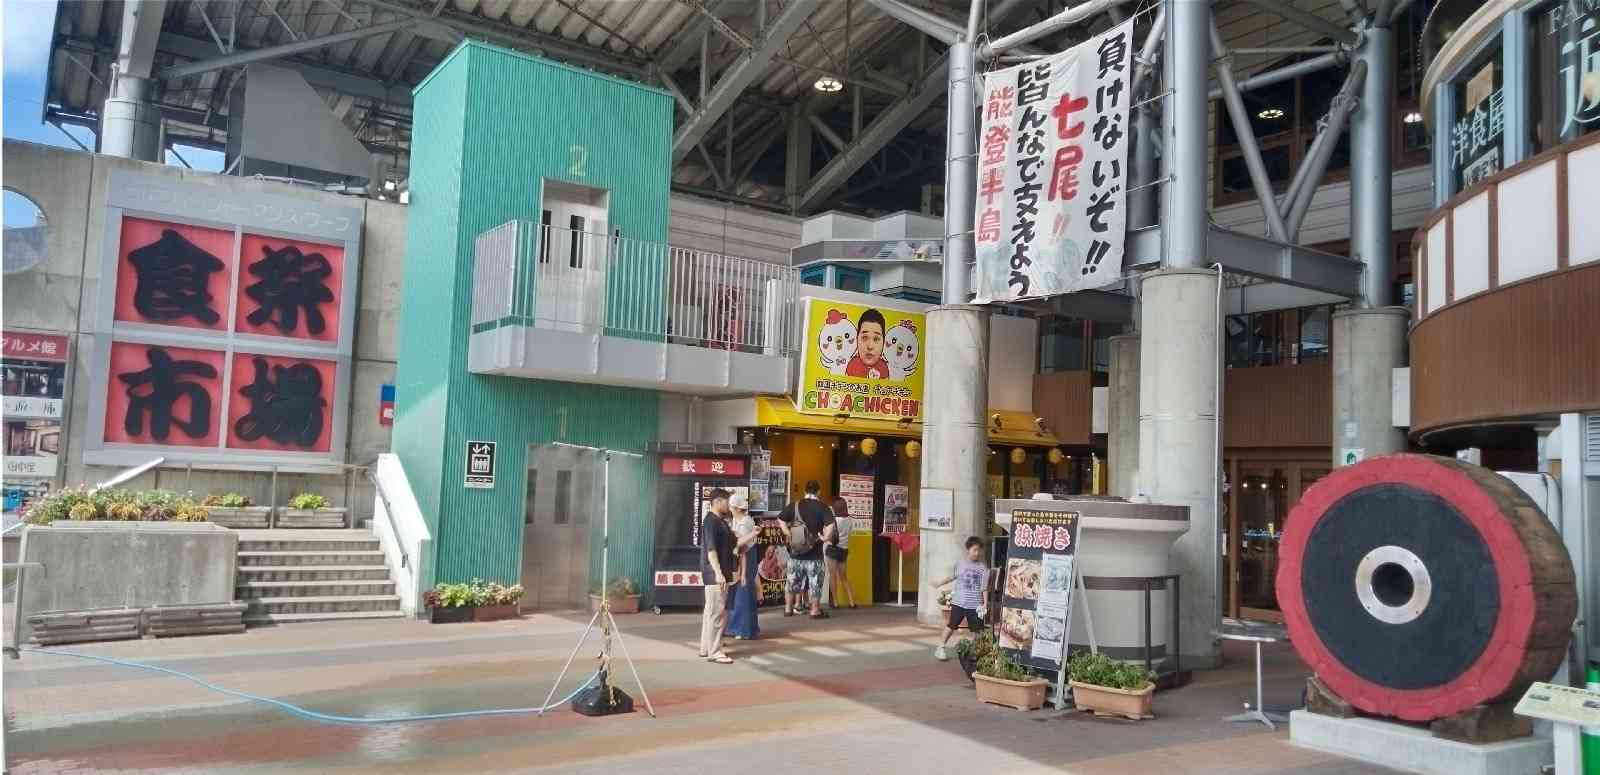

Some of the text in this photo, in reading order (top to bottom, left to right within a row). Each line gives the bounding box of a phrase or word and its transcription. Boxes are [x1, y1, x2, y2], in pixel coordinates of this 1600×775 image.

[976, 85, 1015, 244] 能登半島
[1008, 63, 1051, 297] 皆んなで支えよう
[1014, 524, 1072, 551] 浜焼き
